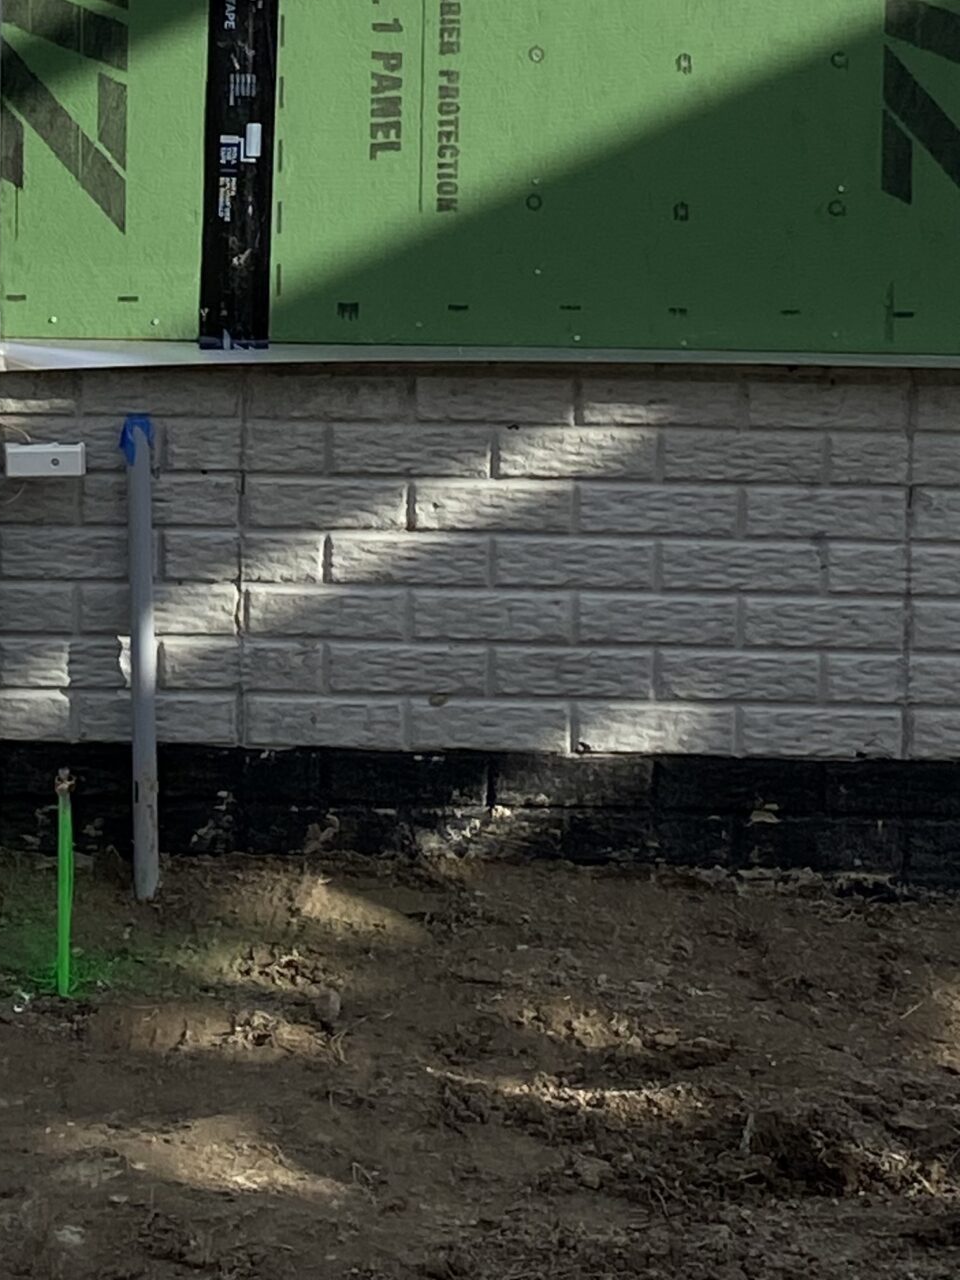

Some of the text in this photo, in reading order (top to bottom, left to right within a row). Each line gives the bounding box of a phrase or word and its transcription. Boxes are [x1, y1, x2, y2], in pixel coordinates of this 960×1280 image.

[371, 17, 404, 34] 1
[368, 50, 403, 161] PANEL
[435, 68, 462, 213] PROTECTION
